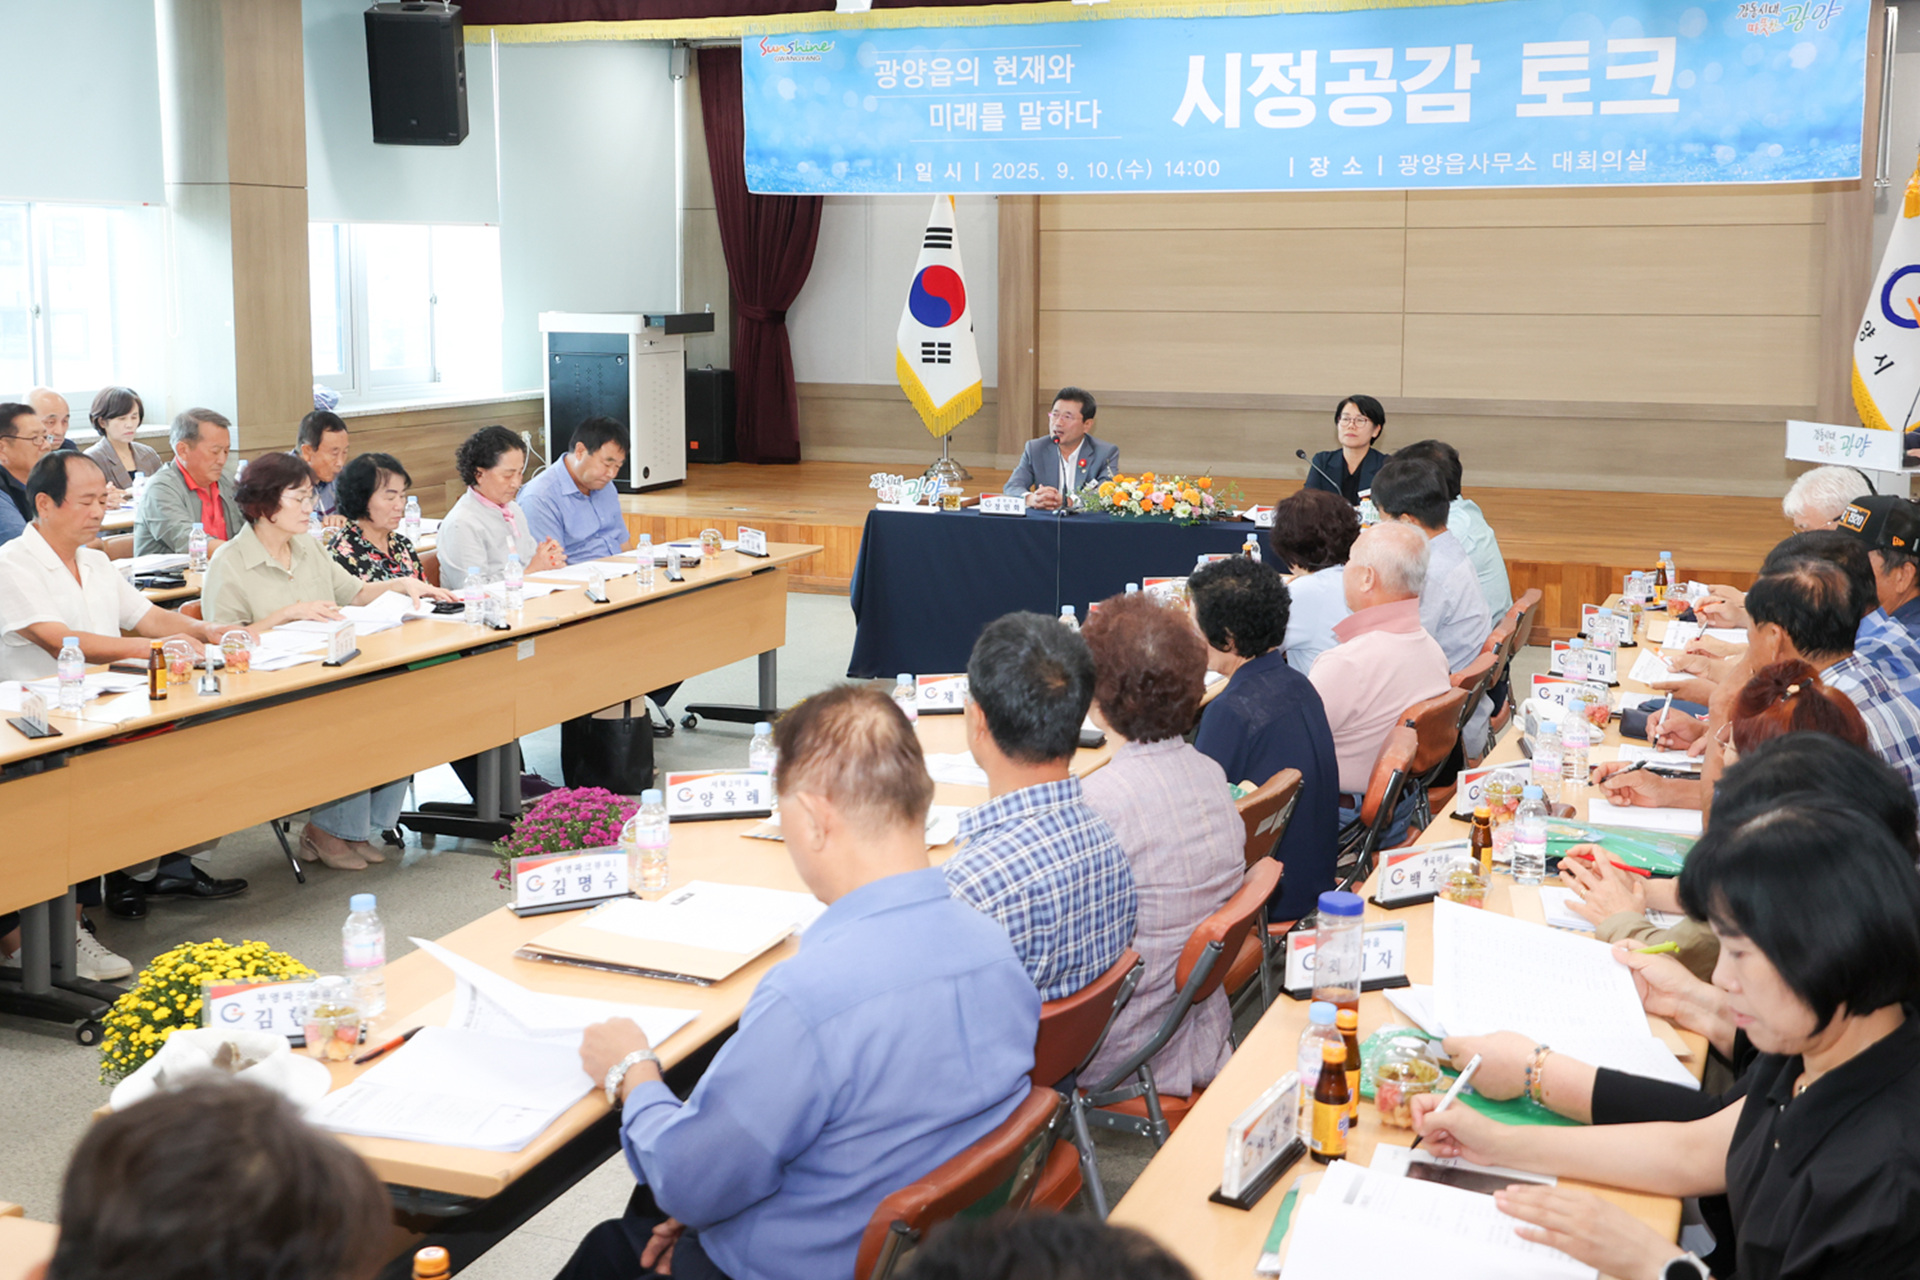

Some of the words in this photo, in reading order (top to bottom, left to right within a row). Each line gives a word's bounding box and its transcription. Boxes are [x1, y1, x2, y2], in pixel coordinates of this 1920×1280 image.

[1783, 0, 1843, 32] 광양
[759, 36, 835, 57] Sunshine
[774, 54, 821, 62] GWANGYANG
[874, 58, 979, 89] 광양읍의
[993, 55, 1075, 86] 현재와
[1172, 44, 1481, 129] 시정공감
[1516, 37, 1680, 118] 토크
[929, 102, 1007, 132] 미래를
[1019, 99, 1103, 131] 말하다
[992, 162, 1045, 181] 2025.
[1057, 162, 1075, 180] 9.
[1165, 159, 1221, 178] 14:00
[1398, 152, 1537, 176] 광양읍사무소
[1552, 149, 1648, 173] 대회의실
[1840, 433, 1872, 458] 광양
[904, 476, 947, 503] 광양
